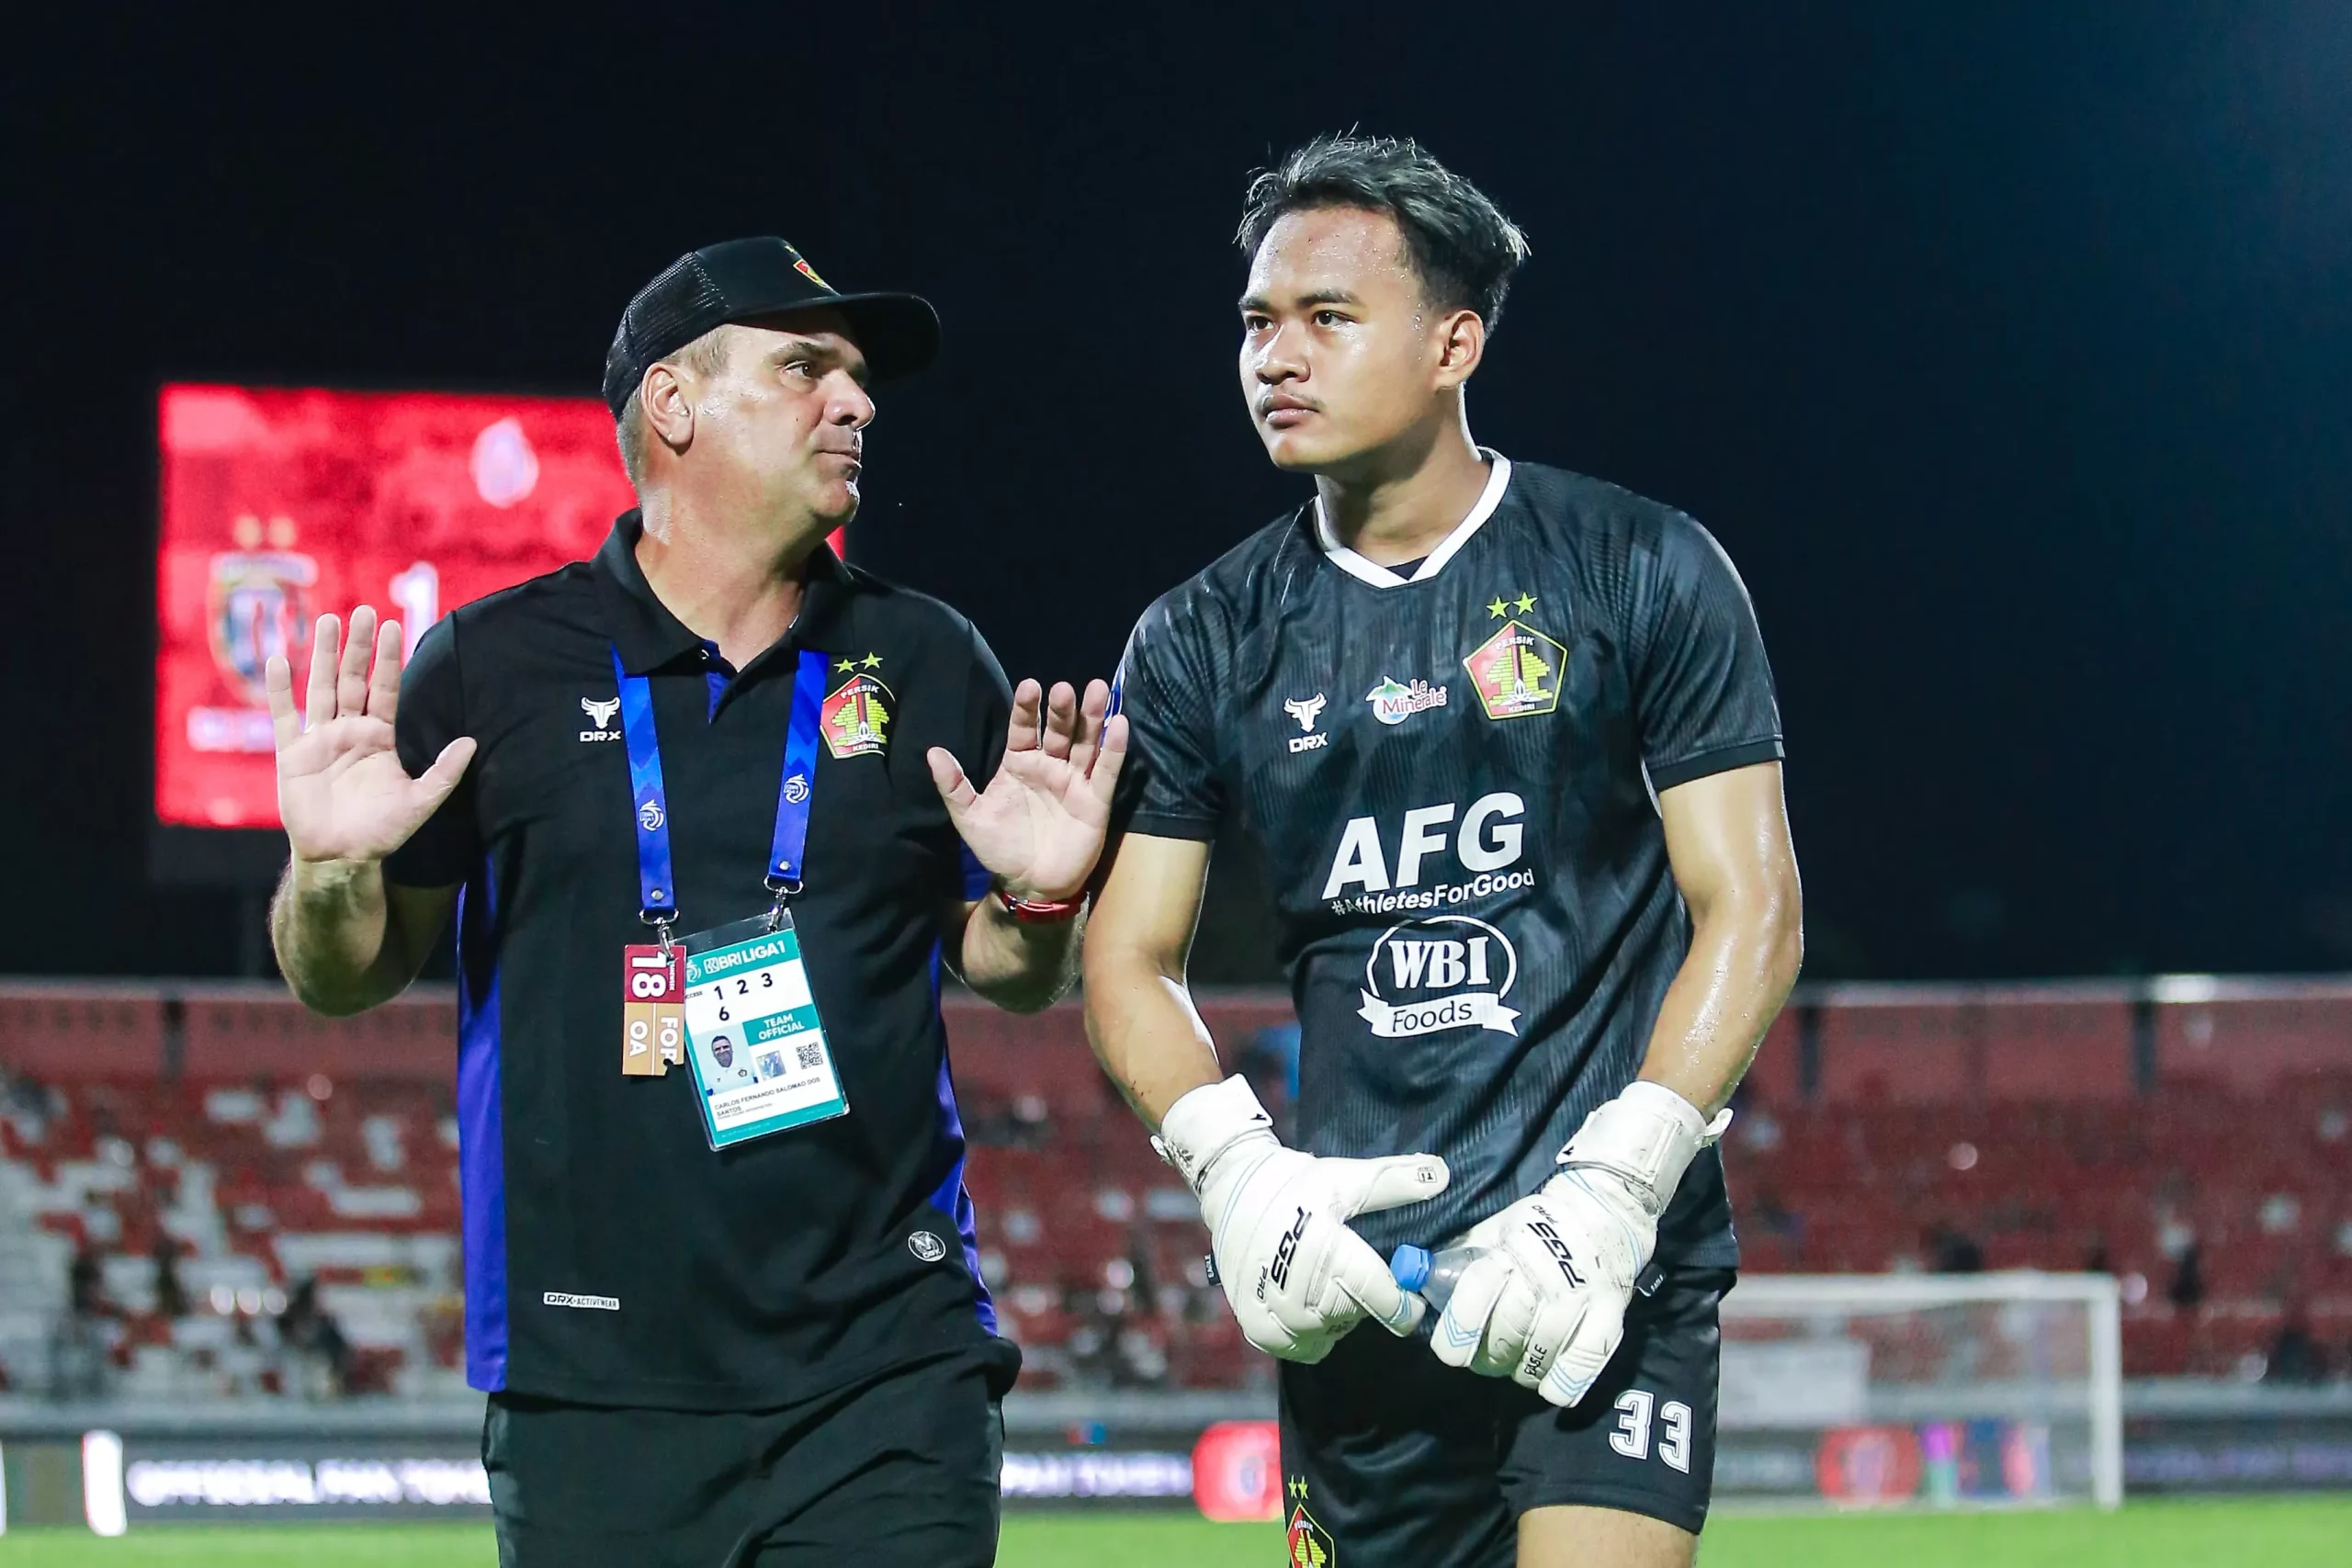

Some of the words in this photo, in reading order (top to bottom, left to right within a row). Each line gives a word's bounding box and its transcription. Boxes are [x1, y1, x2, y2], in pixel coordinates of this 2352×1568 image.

[1495, 636, 1535, 650] PERSIK
[841, 684, 879, 699] PERSIK
[1412, 681, 1427, 696] Le
[1508, 703, 1535, 714] KEDIRI
[580, 730, 622, 742] DRX
[1289, 732, 1329, 753] DRX
[853, 743, 879, 751] KEDIRI
[1322, 792, 1525, 900] AFG
[1331, 868, 1535, 915] #AthletesForGood
[1388, 936, 1490, 989] WBI
[632, 952, 667, 998] 18
[714, 986, 723, 1000] 1
[737, 979, 749, 995] 2
[761, 973, 773, 987] 3
[718, 1007, 729, 1021] 6
[763, 1013, 794, 1028] TEAM
[1392, 1000, 1473, 1032] Foods
[629, 1021, 649, 1056] OA
[758, 1021, 805, 1040] OFFICIAL
[715, 1099, 740, 1110] CARLOS
[741, 1089, 775, 1102] FERNANDO
[775, 1081, 806, 1094] SALOMAO
[808, 1077, 820, 1085] DOS
[717, 1106, 741, 1116] SANTOS
[1532, 1205, 1558, 1224] PRO
[1257, 1266, 1269, 1300] PRO
[547, 1294, 573, 1304] DRX
[1609, 1389, 1692, 1474] 33
[1294, 1520, 1314, 1532] PERSIK
